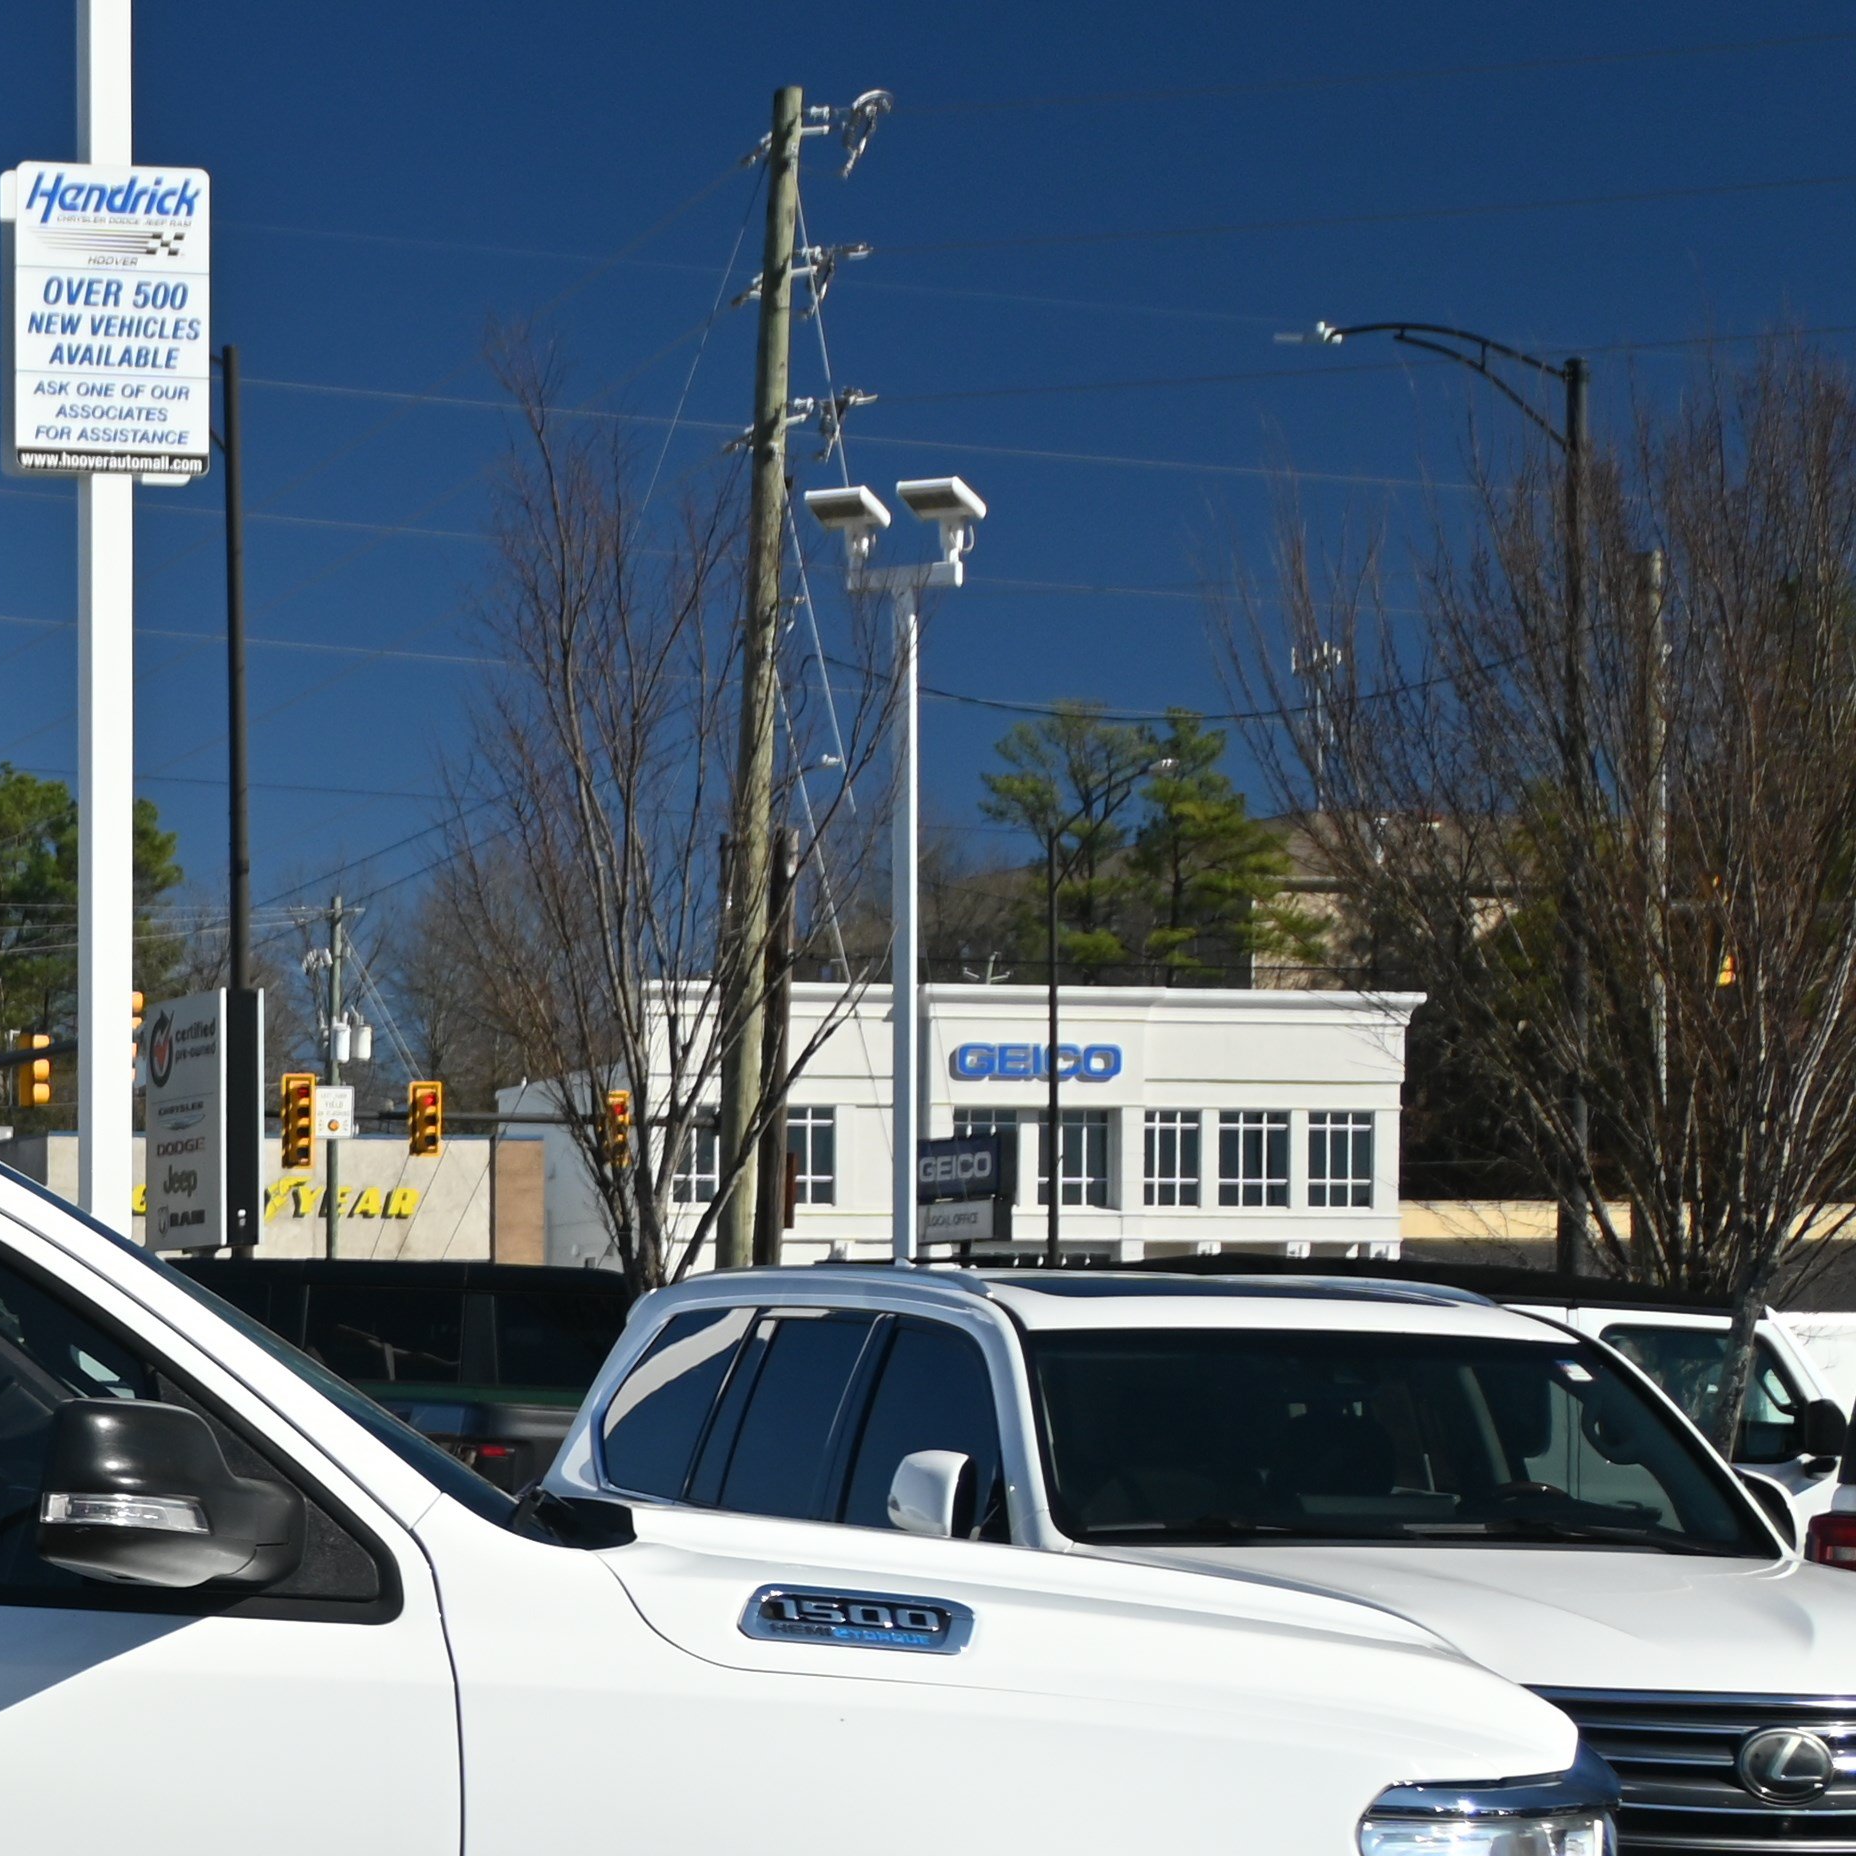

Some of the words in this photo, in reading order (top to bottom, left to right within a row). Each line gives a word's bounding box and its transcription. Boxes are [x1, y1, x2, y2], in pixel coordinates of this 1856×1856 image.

[26, 171, 201, 223] Hendrick
[87, 256, 138, 266] HOOVER
[43, 277, 123, 309] OVER
[133, 283, 189, 310] 500
[28, 312, 82, 336] NEW
[90, 315, 201, 341] VEHICLES
[49, 343, 179, 369] AVAILABLE
[34, 381, 70, 396] ASK
[76, 383, 115, 398] ONE
[121, 384, 145, 399] OF
[151, 385, 190, 400] OUR
[55, 404, 168, 422] ASSOCIATES
[35, 426, 72, 441] FOR
[77, 427, 189, 445] ASSISTANCE
[21, 451, 202, 473] www.hooverautomall.com
[175, 1017, 216, 1042] certified
[956, 1043, 1122, 1077] GEICO
[158, 1101, 204, 1116] CHRYSLER
[157, 1136, 206, 1156] DODGE
[919, 1151, 991, 1182] GEICO
[163, 1165, 198, 1198] Jeep
[170, 1209, 205, 1229] RAM
[773, 1598, 939, 1631] 1500
[770, 1623, 832, 1638] HEMI
